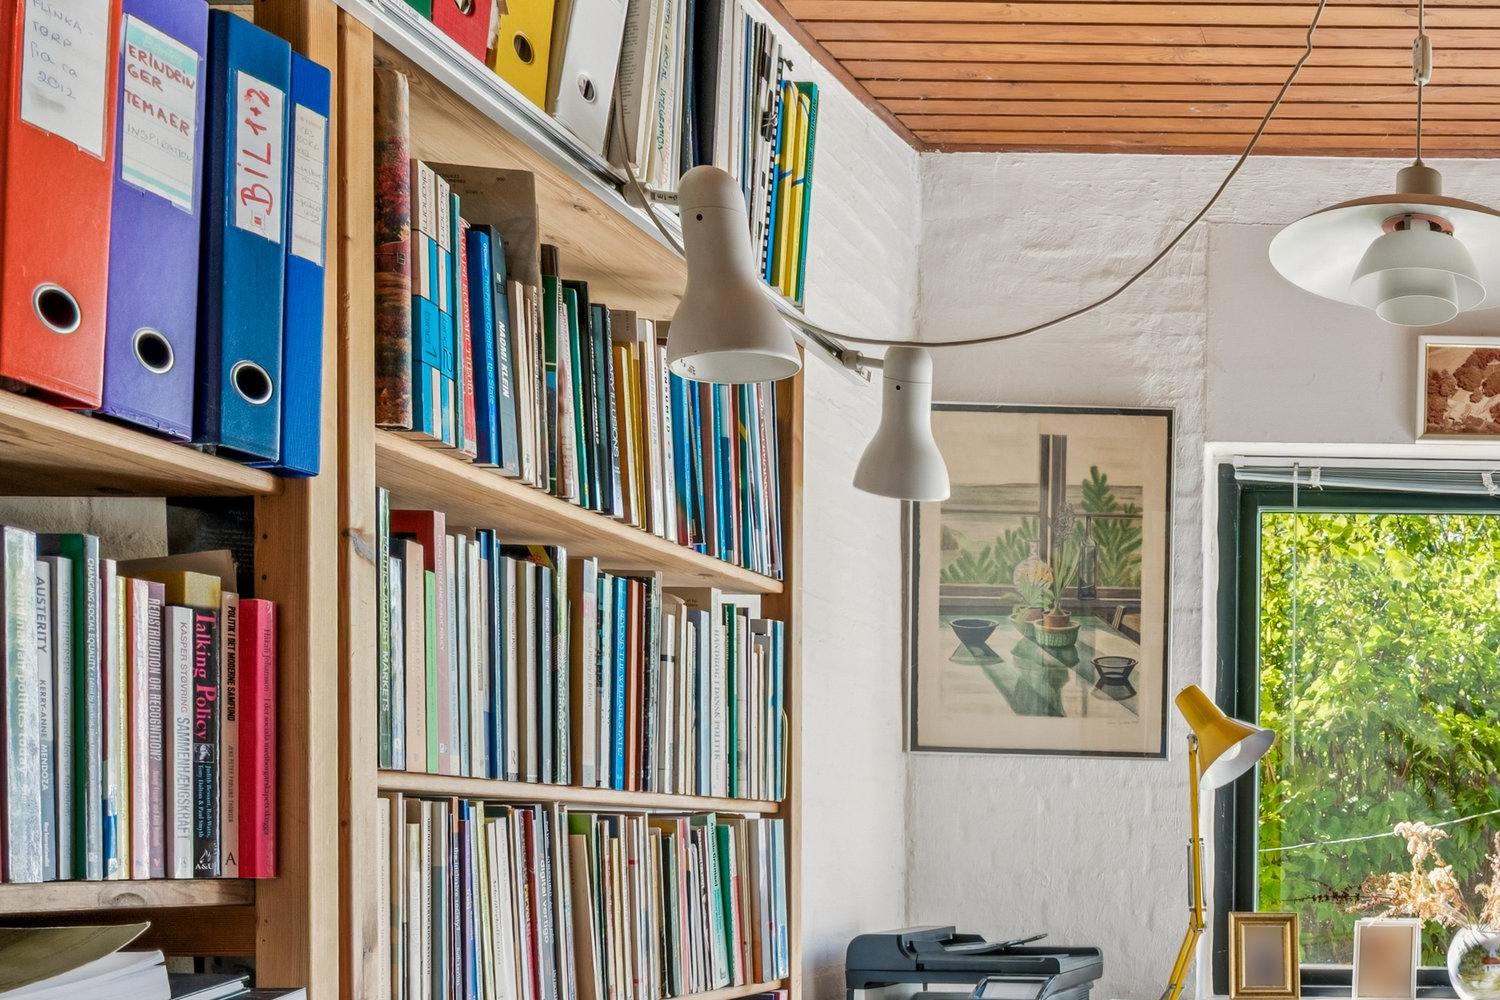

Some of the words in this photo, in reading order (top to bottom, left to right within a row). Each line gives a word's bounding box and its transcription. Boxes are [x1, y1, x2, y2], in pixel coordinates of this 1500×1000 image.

[127, 63, 164, 93] GER
[124, 88, 190, 137] TEMAER
[499, 321, 507, 361] NAOMI
[501, 364, 510, 398] KLEIN
[87, 558, 96, 601] CHANGING
[36, 576, 48, 654] AUSTERITY
[88, 604, 96, 631] SOCIAL
[226, 605, 236, 631] POLITIK
[88, 633, 96, 671] EQUALITY
[148, 598, 161, 675] REDISTRIBUTION
[179, 622, 189, 661] KASPER
[193, 611, 216, 679] Talking
[149, 677, 161, 692] OR
[180, 664, 189, 713] STØVRING
[227, 652, 236, 685] MODERNE
[39, 679, 48, 737] KERRY-ANNE
[193, 684, 216, 740] Policy
[227, 687, 236, 721] SAMFUND
[149, 694, 162, 761] RECOGNITION?
[40, 744, 50, 791] MENDOZA
